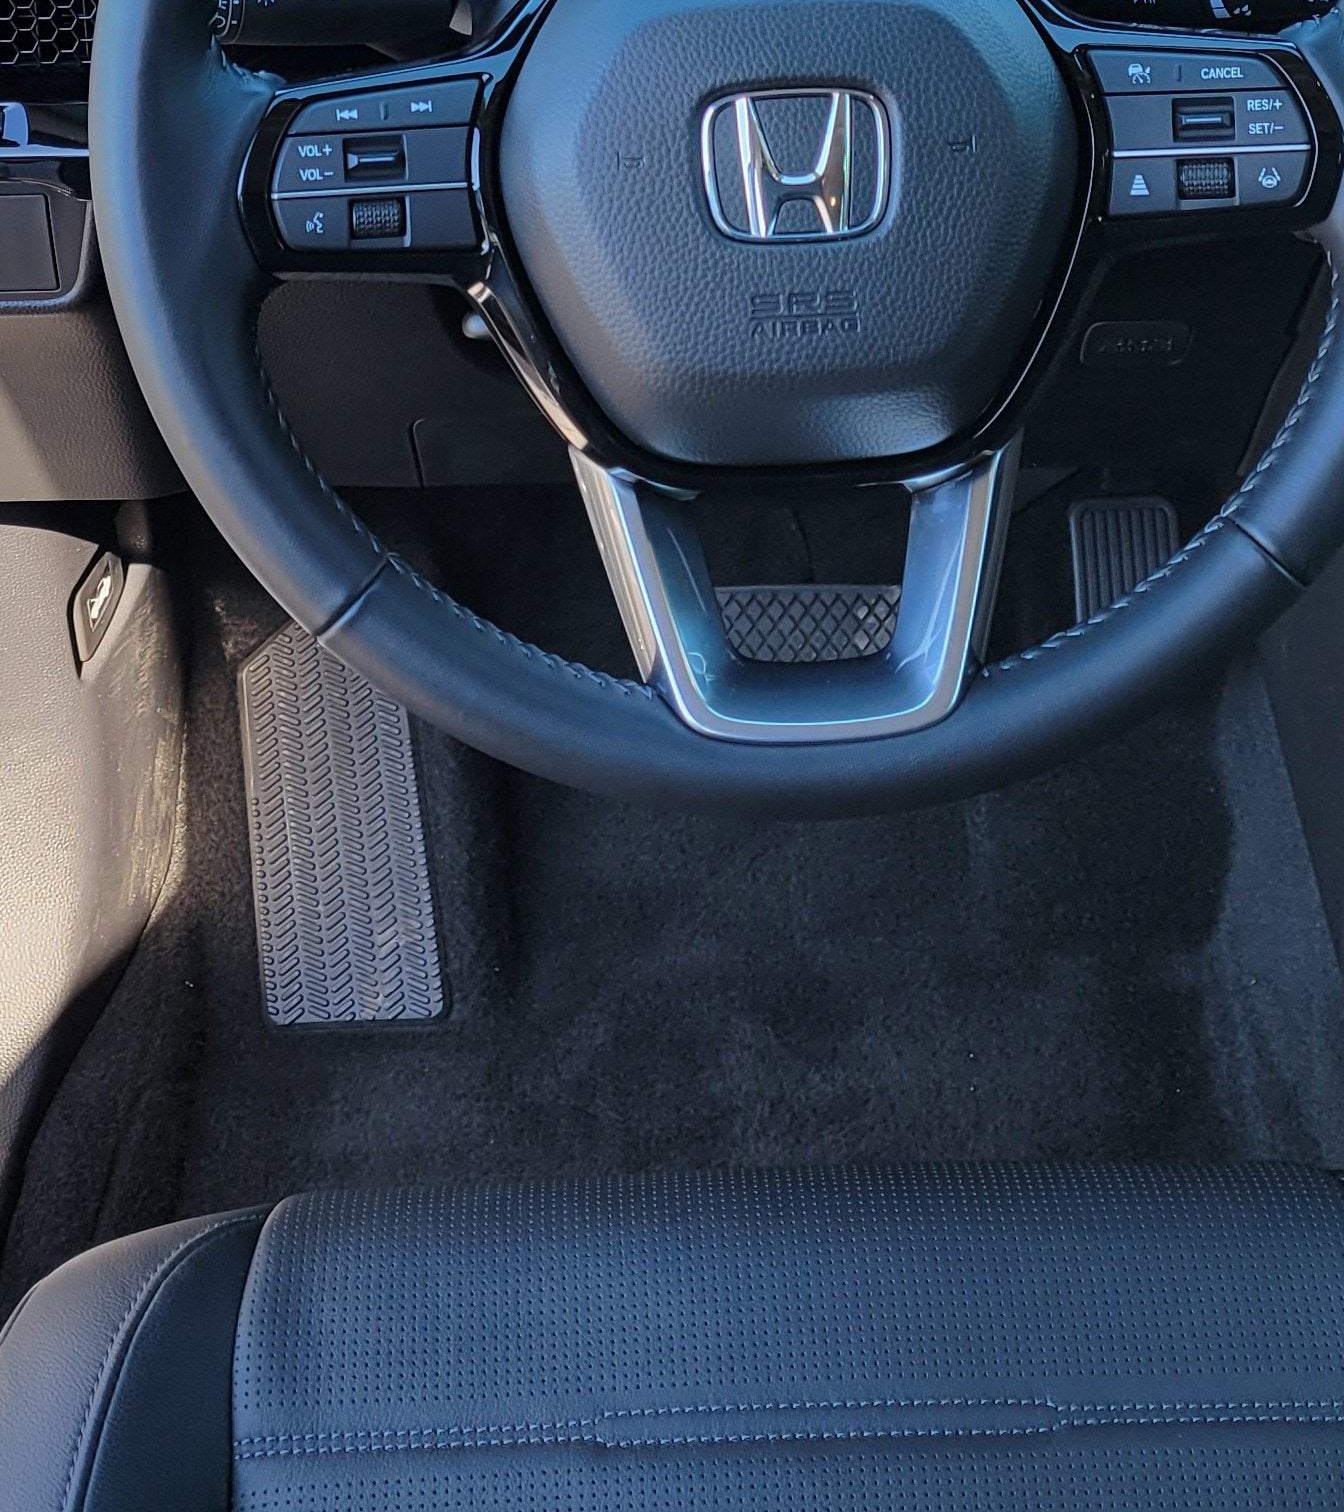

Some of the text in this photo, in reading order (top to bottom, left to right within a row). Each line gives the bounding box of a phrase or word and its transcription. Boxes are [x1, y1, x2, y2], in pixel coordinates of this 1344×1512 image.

[1201, 66, 1244, 80] CANCEL
[1246, 99, 1283, 112] RES/+
[751, 291, 858, 315] SRS
